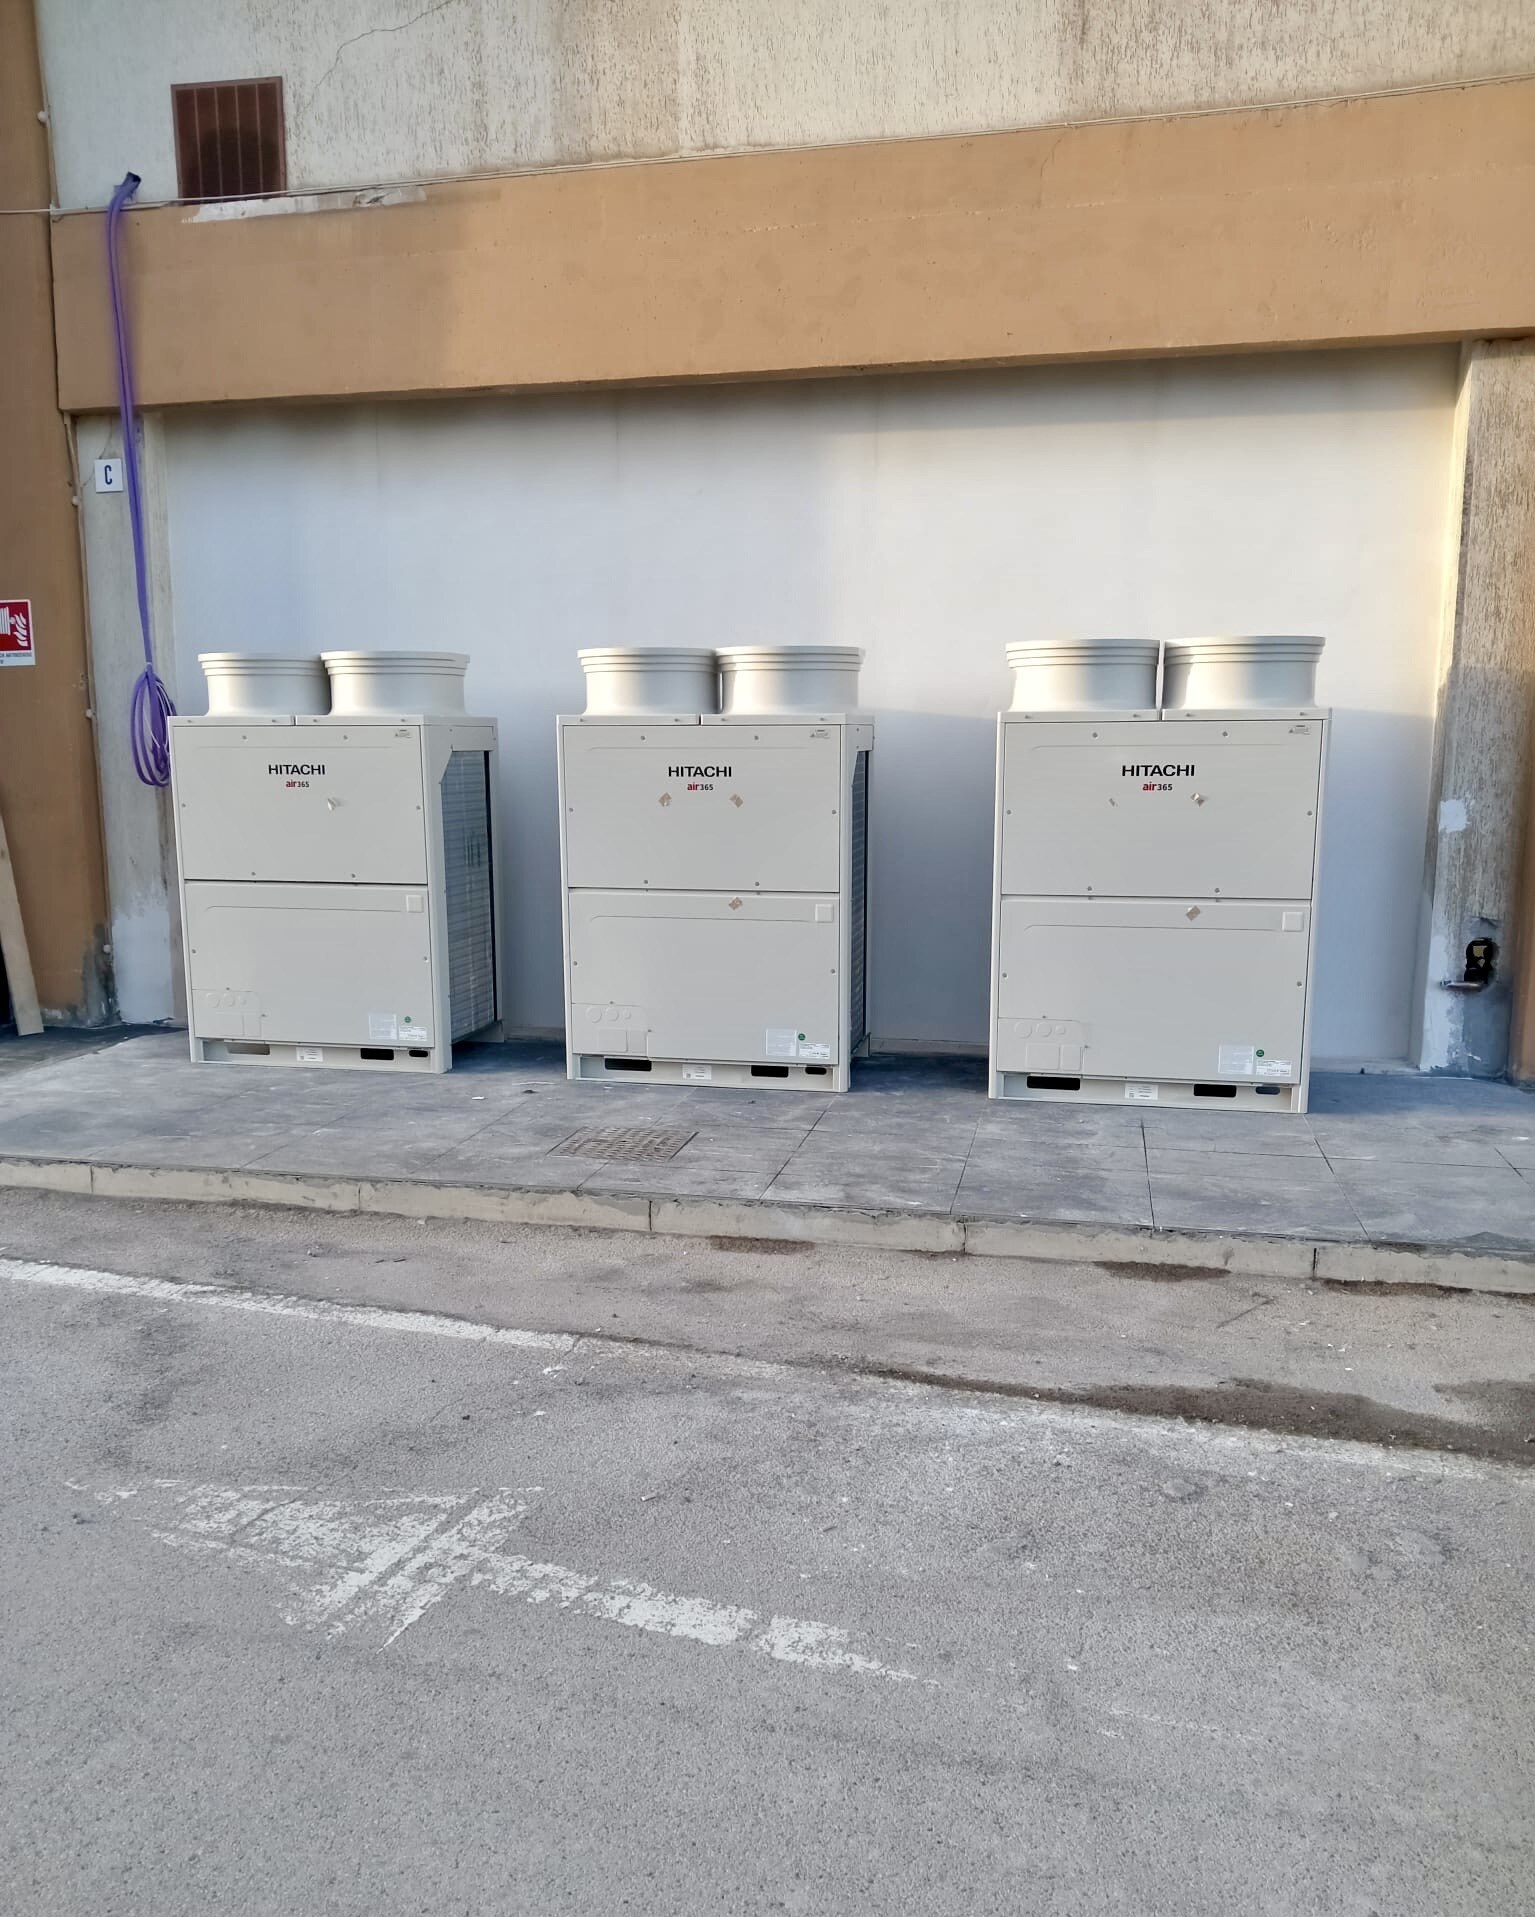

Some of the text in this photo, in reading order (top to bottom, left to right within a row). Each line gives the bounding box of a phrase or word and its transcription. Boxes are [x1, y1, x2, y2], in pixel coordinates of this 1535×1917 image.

[104, 464, 113, 485] C
[268, 764, 326, 775] HITACHI
[668, 766, 732, 777] HITACHI
[1121, 764, 1195, 777] HITACHI
[687, 781, 714, 791] air365
[1142, 781, 1173, 791] air365
